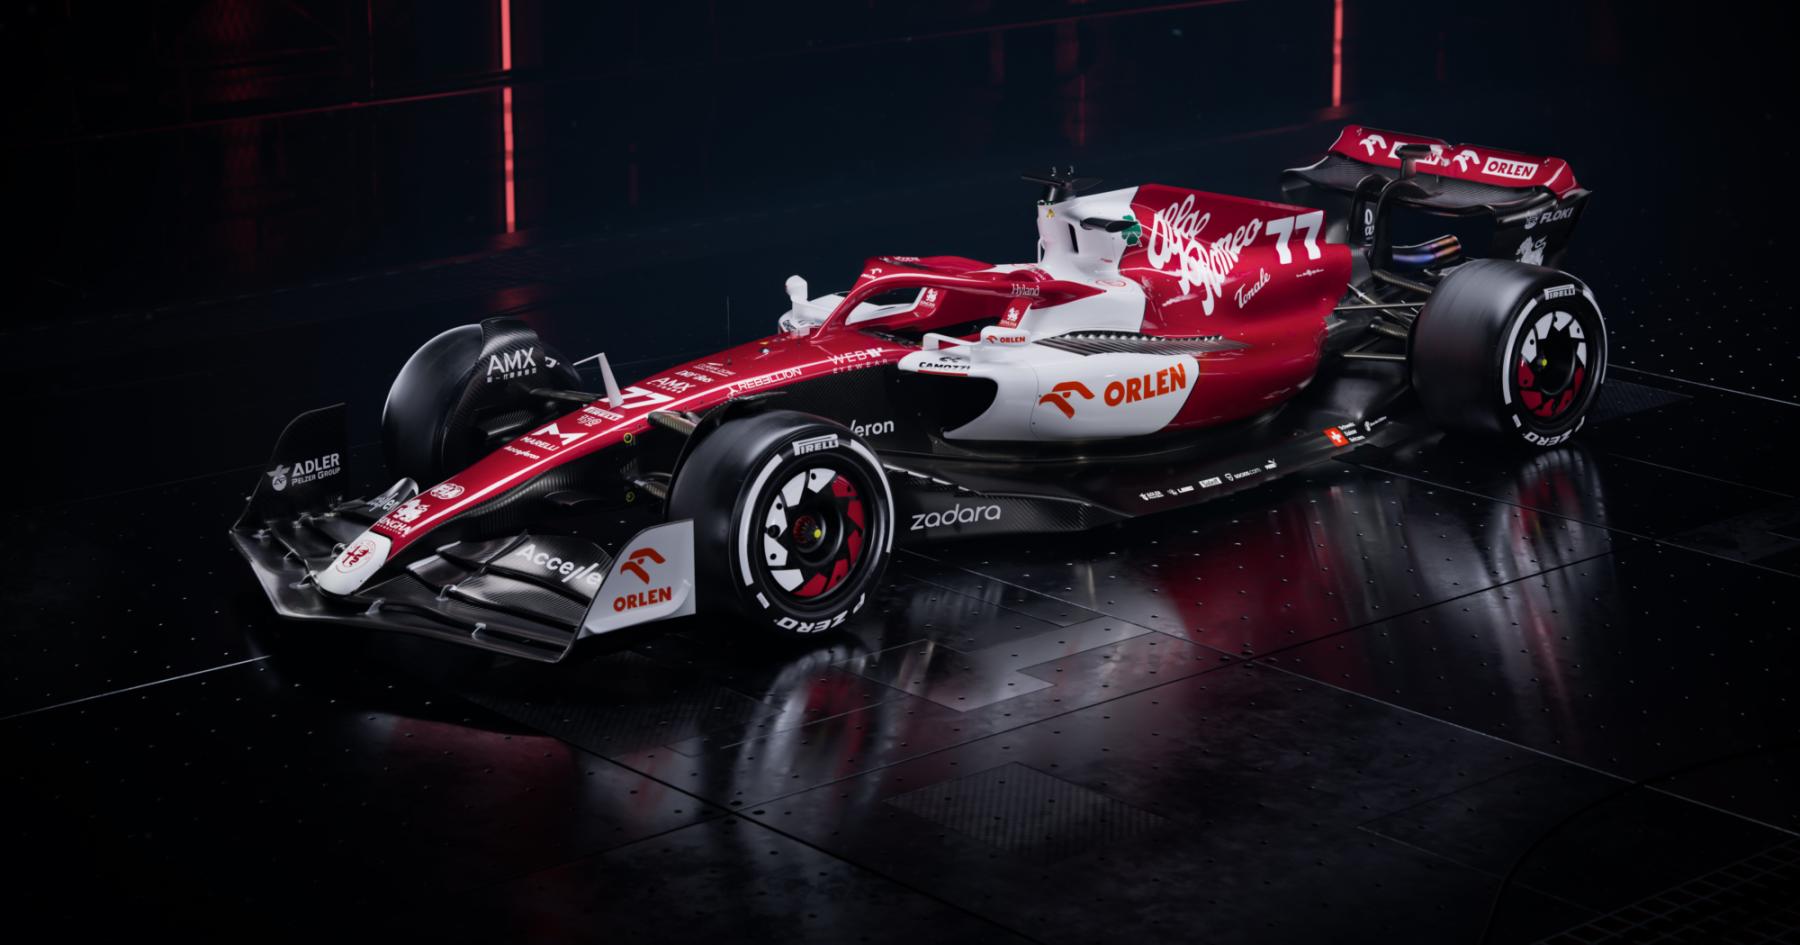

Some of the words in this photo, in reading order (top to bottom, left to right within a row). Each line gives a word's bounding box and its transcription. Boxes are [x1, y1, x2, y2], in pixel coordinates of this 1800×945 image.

[1487, 160, 1534, 178] ORLEN
[1540, 207, 1575, 225] FLOKI
[1148, 194, 1211, 270] Alfa
[1265, 210, 1324, 265] 77
[1178, 218, 1263, 316] Romeo
[1011, 283, 1040, 297] Hyland
[1234, 267, 1271, 309] Tonale
[1543, 284, 1575, 301] PIRELLI
[487, 347, 536, 376] AMX
[828, 350, 869, 365] WEB
[832, 359, 888, 374] EYEWEAR
[648, 377, 696, 392] AMX
[738, 368, 802, 391] REBELLION
[1103, 362, 1186, 407] ORLEN
[519, 436, 560, 451] MARELLI
[792, 433, 839, 457] PIRELLI
[292, 452, 340, 478] ADLER
[910, 503, 1001, 531] zadara
[613, 586, 673, 613] ORLEN
[775, 610, 849, 633] ZERO
